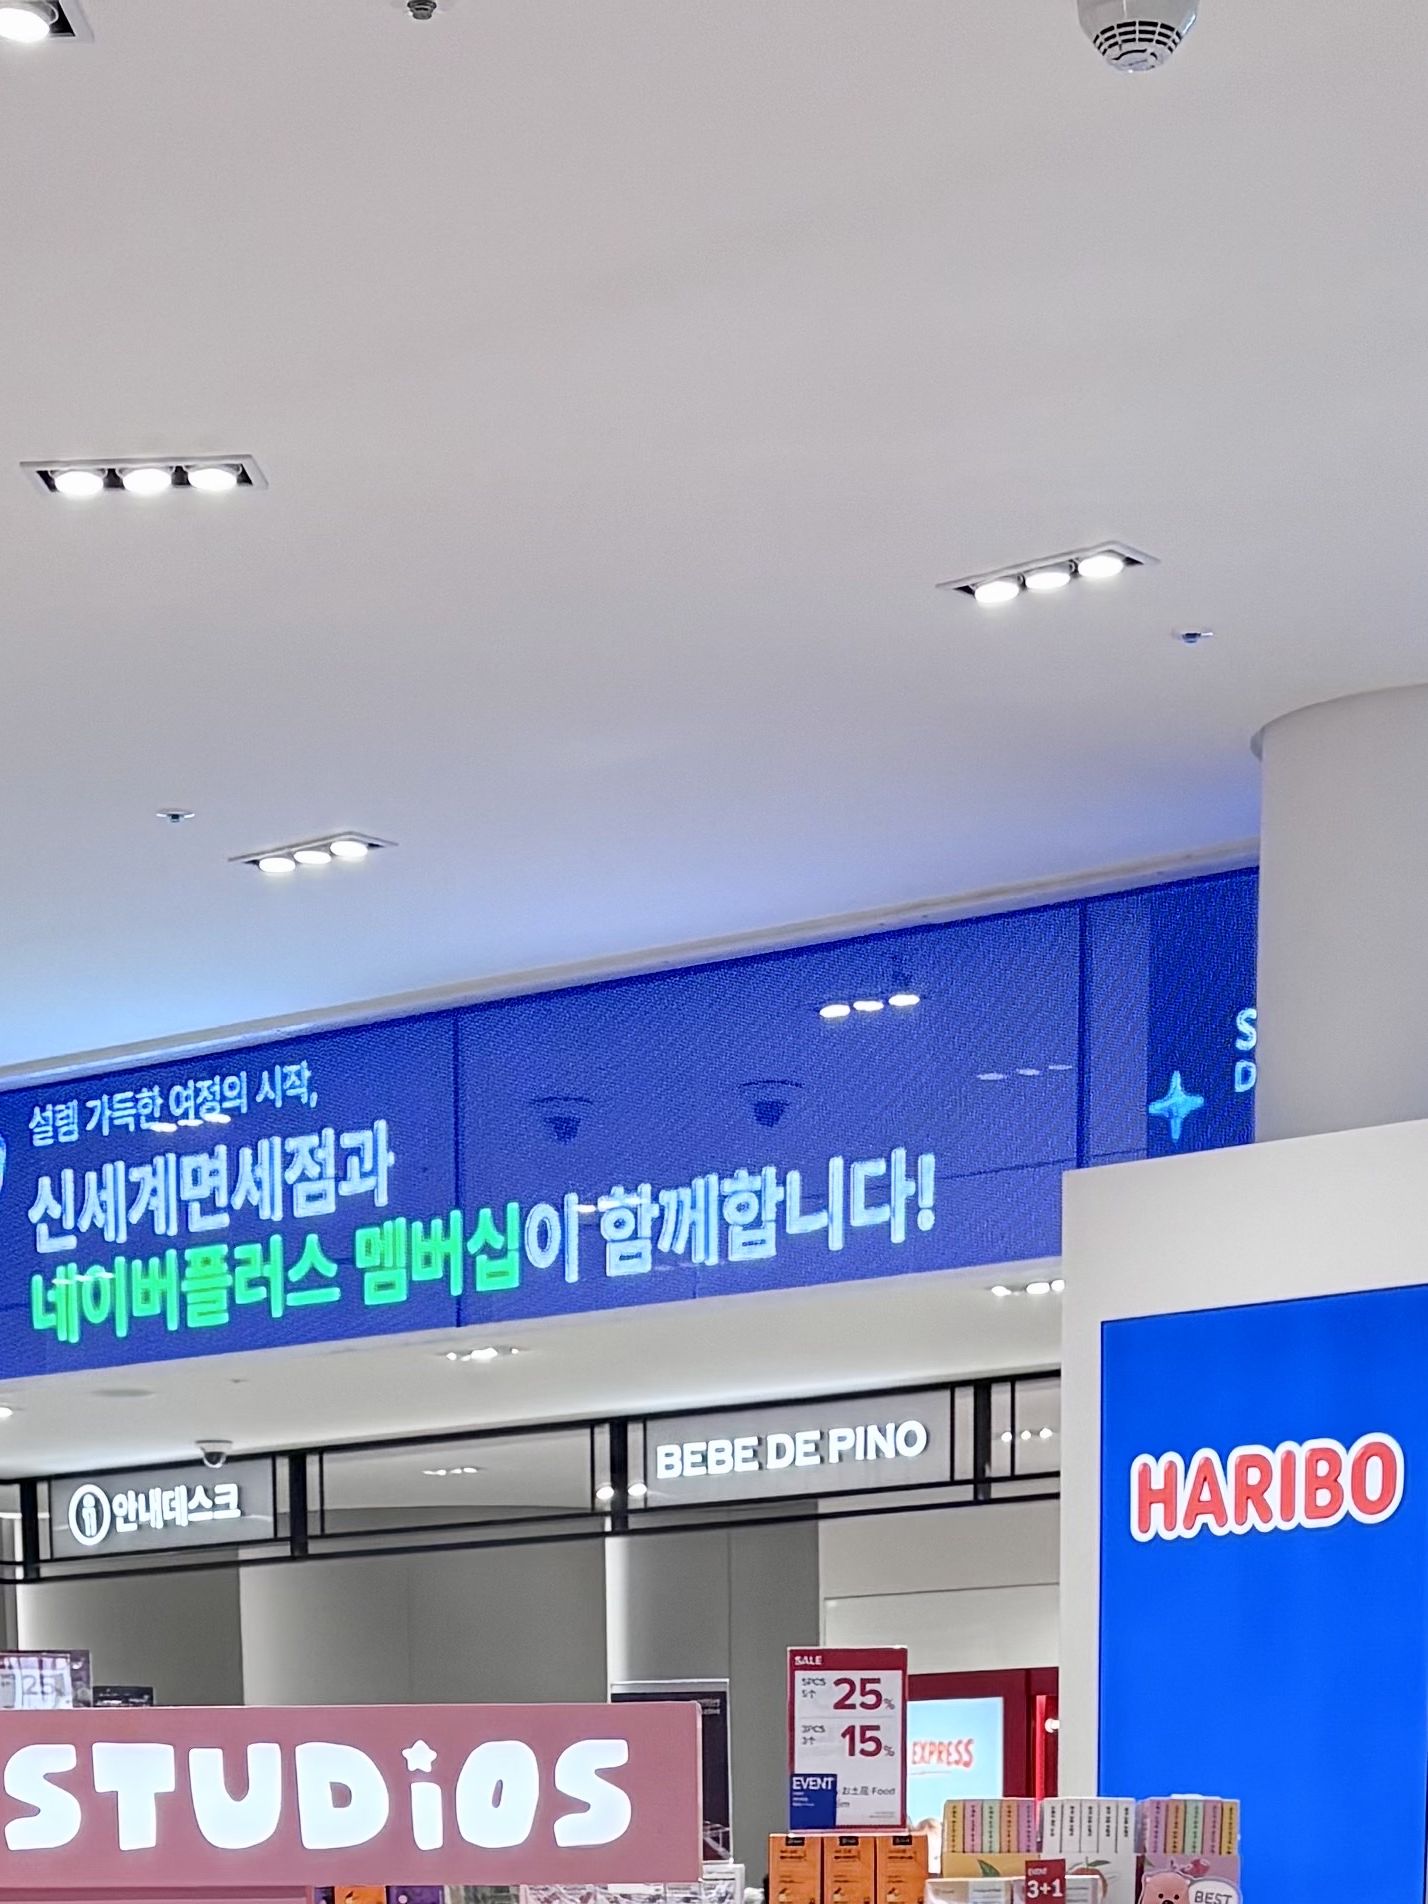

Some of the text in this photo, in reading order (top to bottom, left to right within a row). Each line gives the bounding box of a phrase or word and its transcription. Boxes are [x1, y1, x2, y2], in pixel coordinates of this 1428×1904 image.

[28, 1059, 319, 1147] 설렘 가득한 여정의 시작,
[28, 1117, 396, 1255] 신세계면세점과
[31, 1147, 937, 1344] 네이버플러스 멤버십이 함께합니다!
[656, 1419, 928, 1480] BEBE DE PINO
[112, 1481, 243, 1534] 안내데스크
[1132, 1433, 1403, 1541] HARIBO
[794, 1655, 823, 1666] SALE
[911, 1738, 975, 1769] EXPRESS
[3, 1737, 634, 1853] STUDiOS
[791, 1776, 835, 1791] EVENT
[871, 1786, 896, 1796] Food
[1027, 1880, 1065, 1900] 3+1
